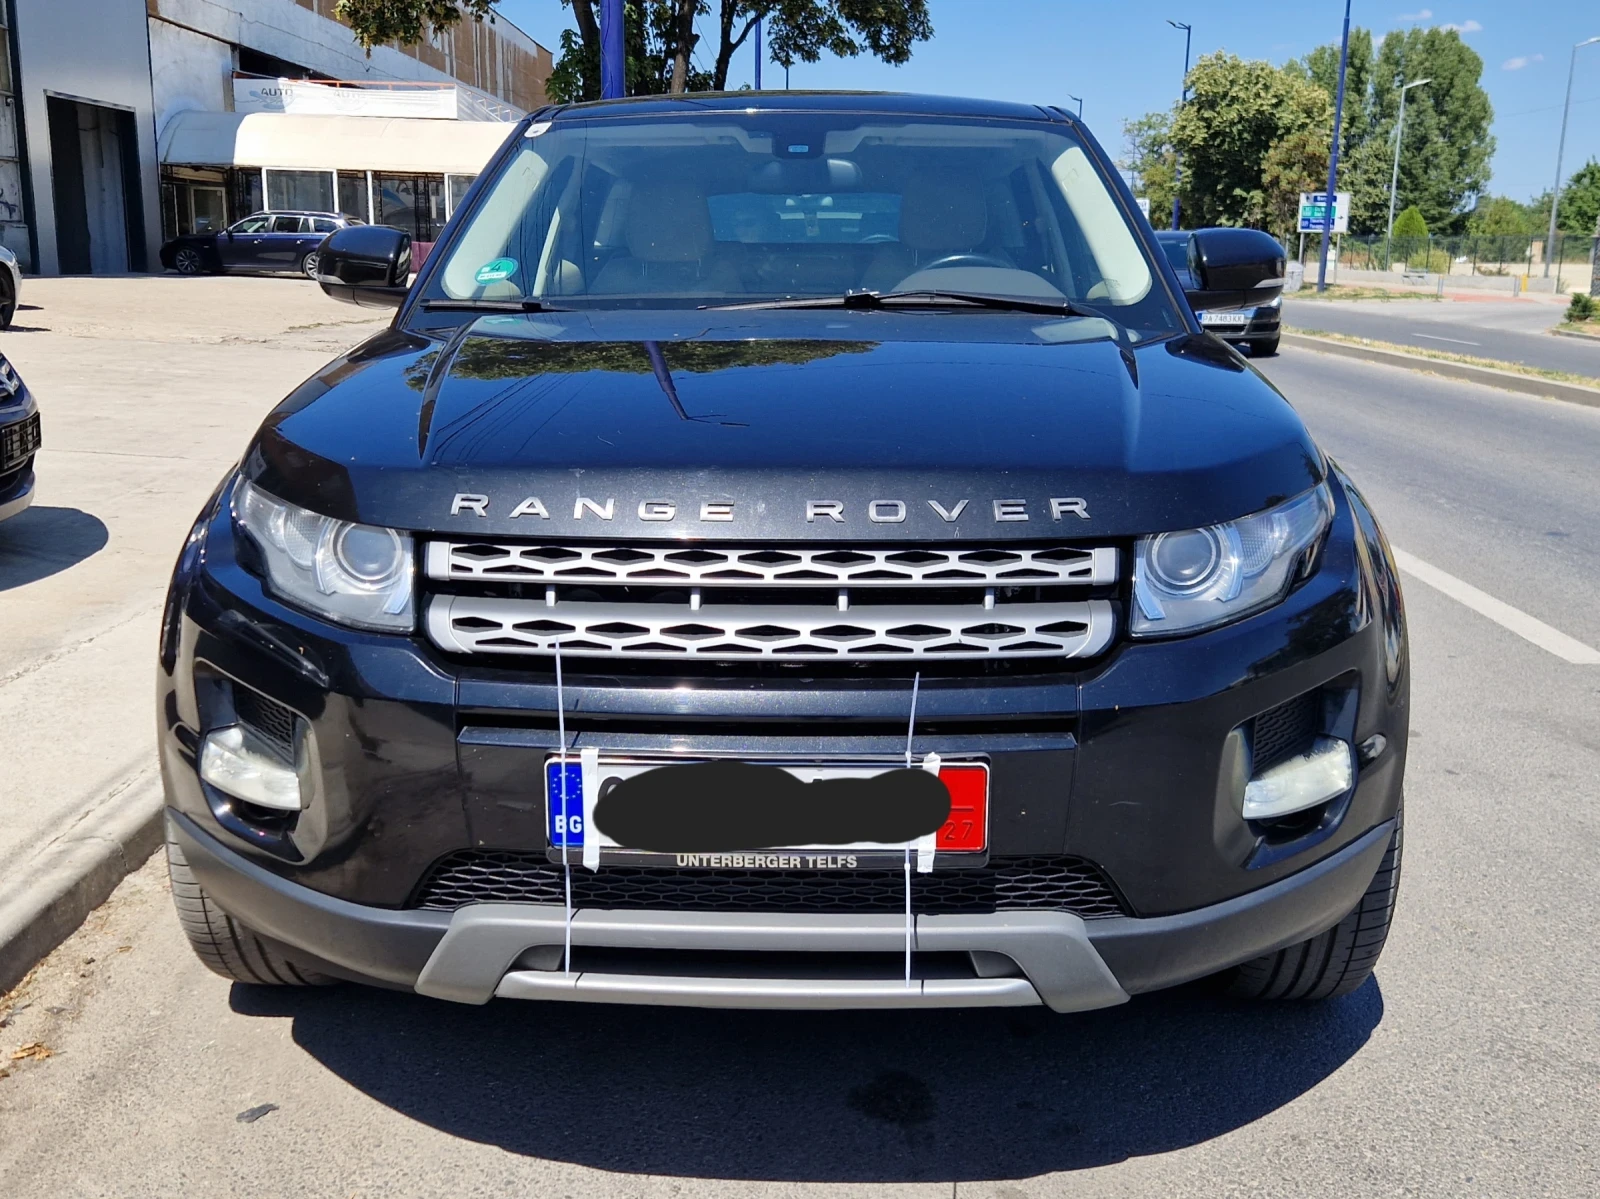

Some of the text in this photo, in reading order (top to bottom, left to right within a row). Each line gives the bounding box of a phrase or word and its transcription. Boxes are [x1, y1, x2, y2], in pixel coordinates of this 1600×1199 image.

[261, 87, 293, 97] AUTO
[491, 261, 502, 271] 4
[450, 493, 1091, 523] RANGE ROVER
[555, 814, 582, 834] BG
[944, 820, 974, 841] 27
[676, 853, 858, 869] UNTERBERGER TELFS
